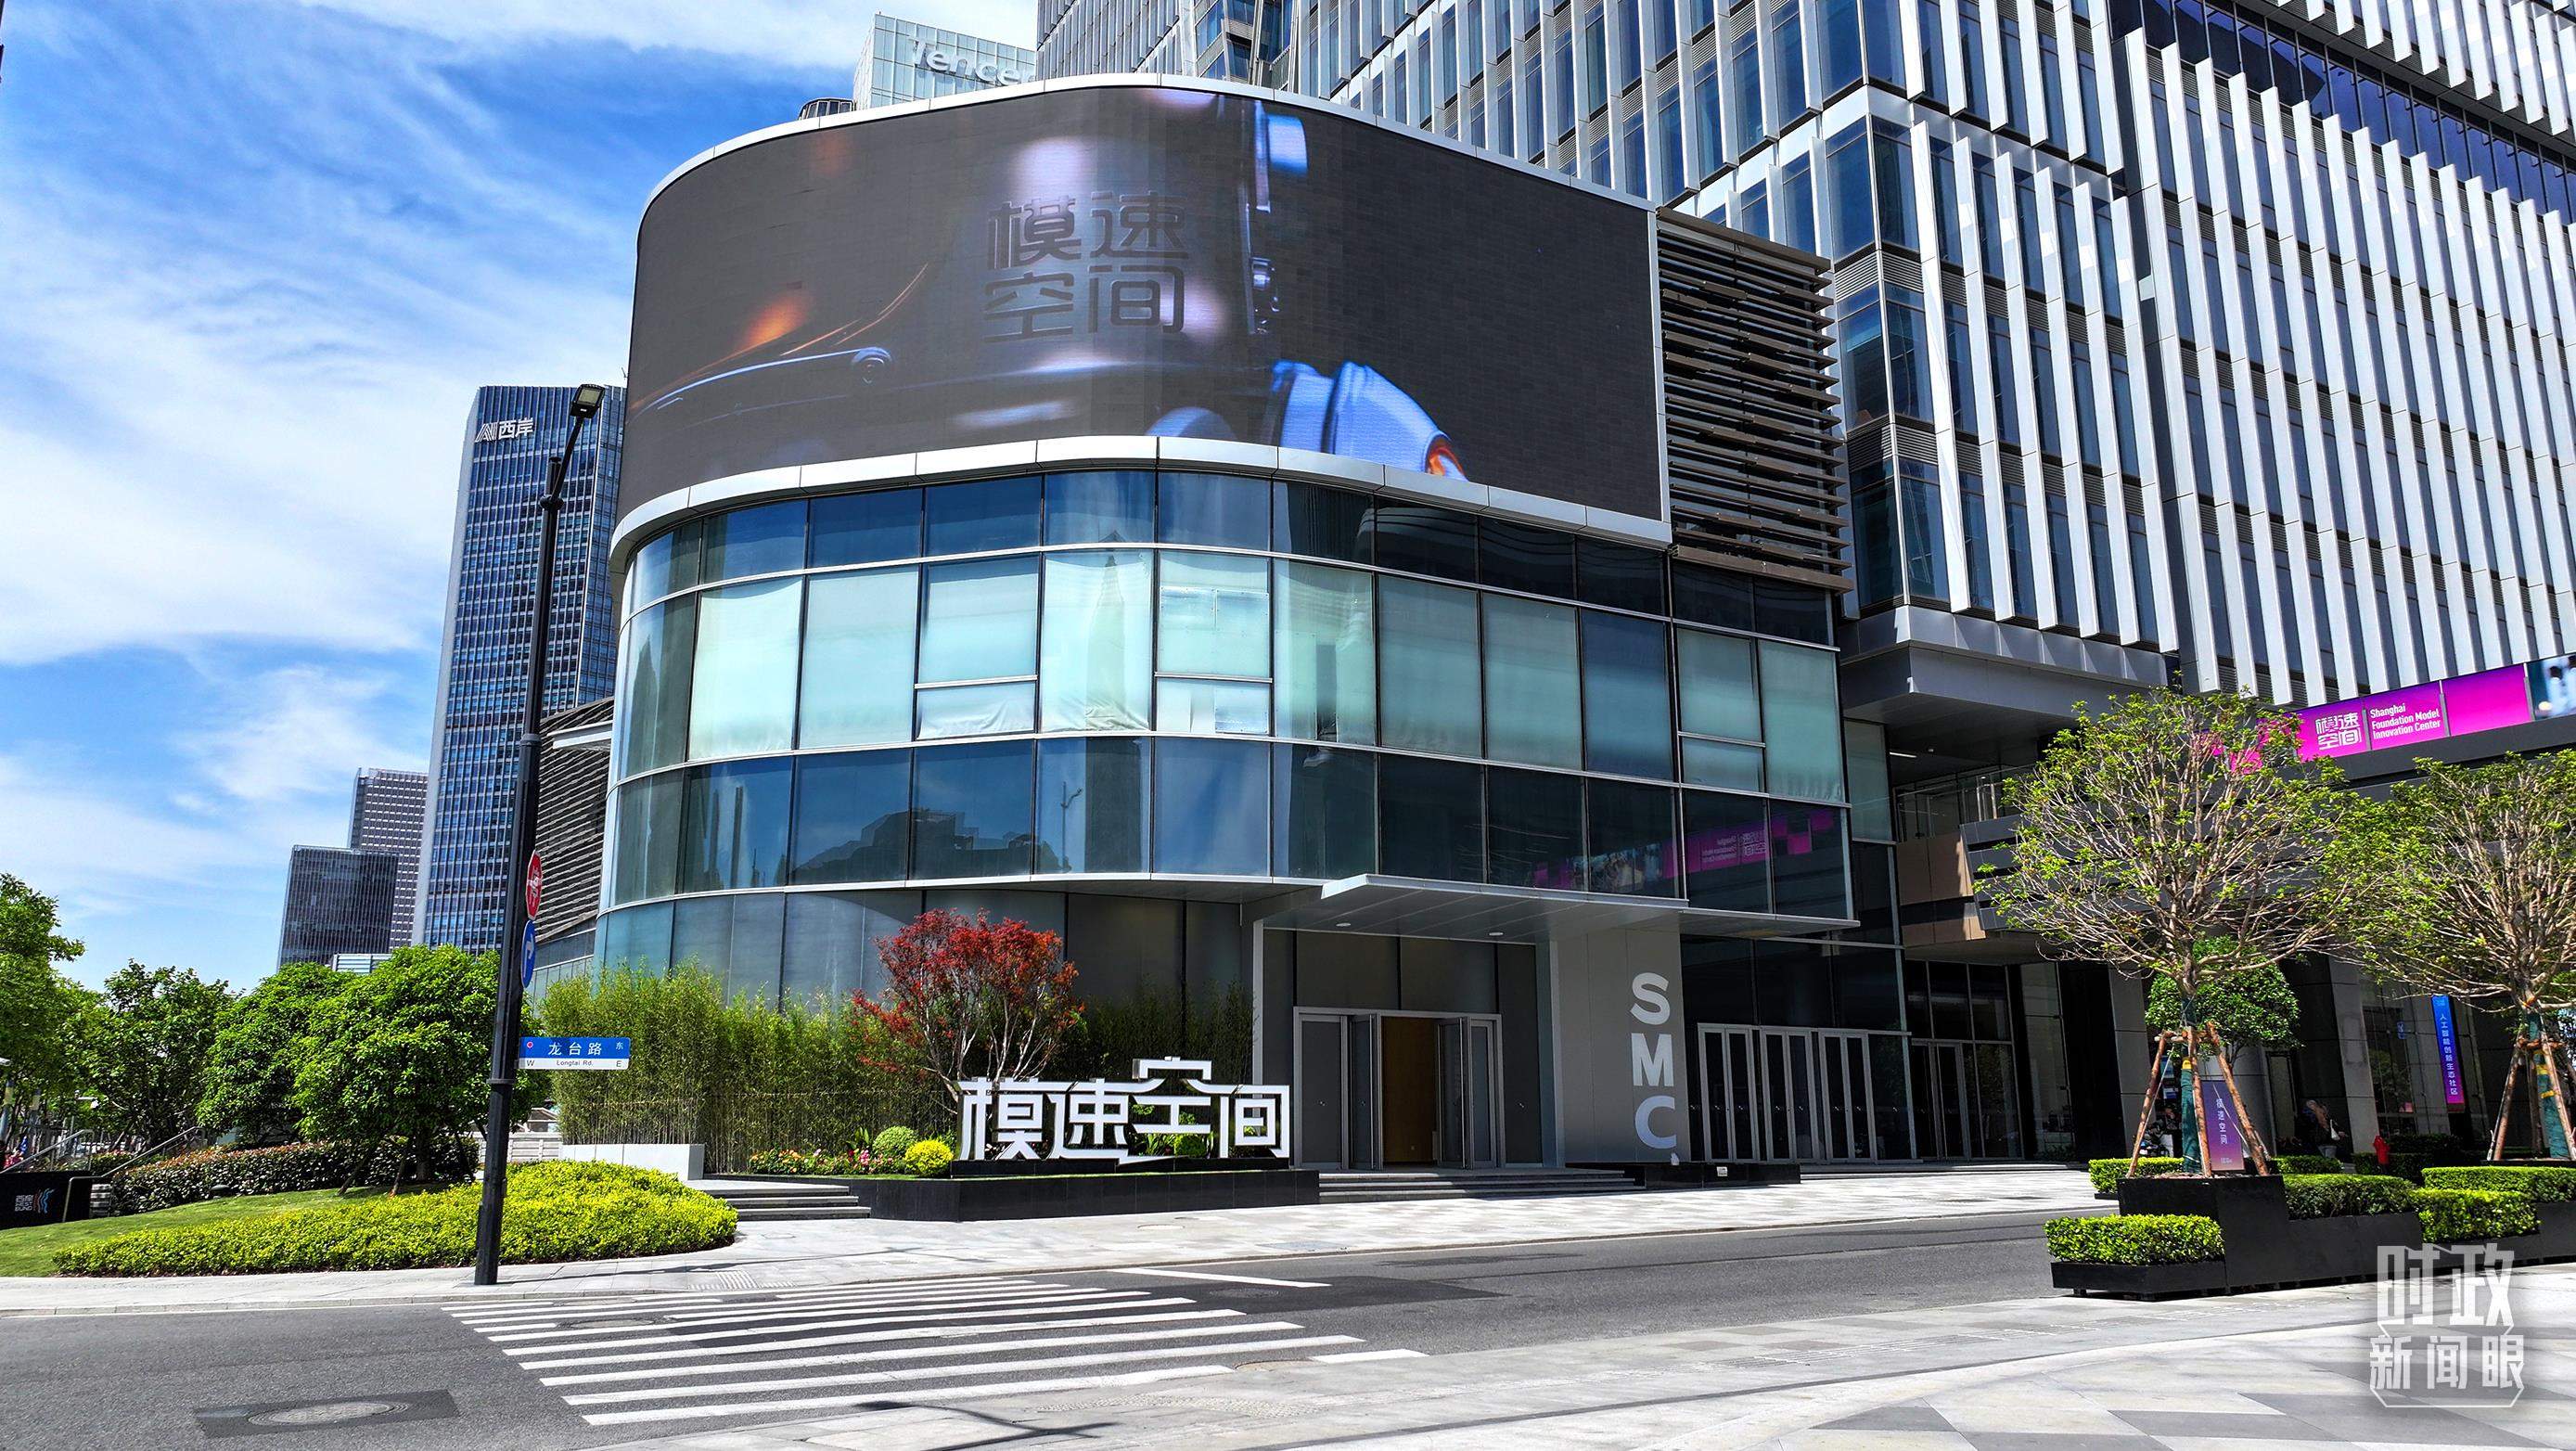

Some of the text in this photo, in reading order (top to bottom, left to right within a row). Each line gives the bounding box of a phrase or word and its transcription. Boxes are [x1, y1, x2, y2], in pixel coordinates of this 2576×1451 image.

[988, 190, 1189, 269] 模速
[982, 265, 1185, 343] 空间
[2370, 703, 2406, 718] Shanghai
[2372, 708, 2440, 730] Foundation Model
[2315, 712, 2360, 734] 模速
[2373, 720, 2441, 739] Innovation Center
[2318, 727, 2362, 751] 空间
[548, 1042, 623, 1056] 龙台路 东
[1630, 972, 1677, 1149] SMC
[957, 1056, 1290, 1165] 模速空间
